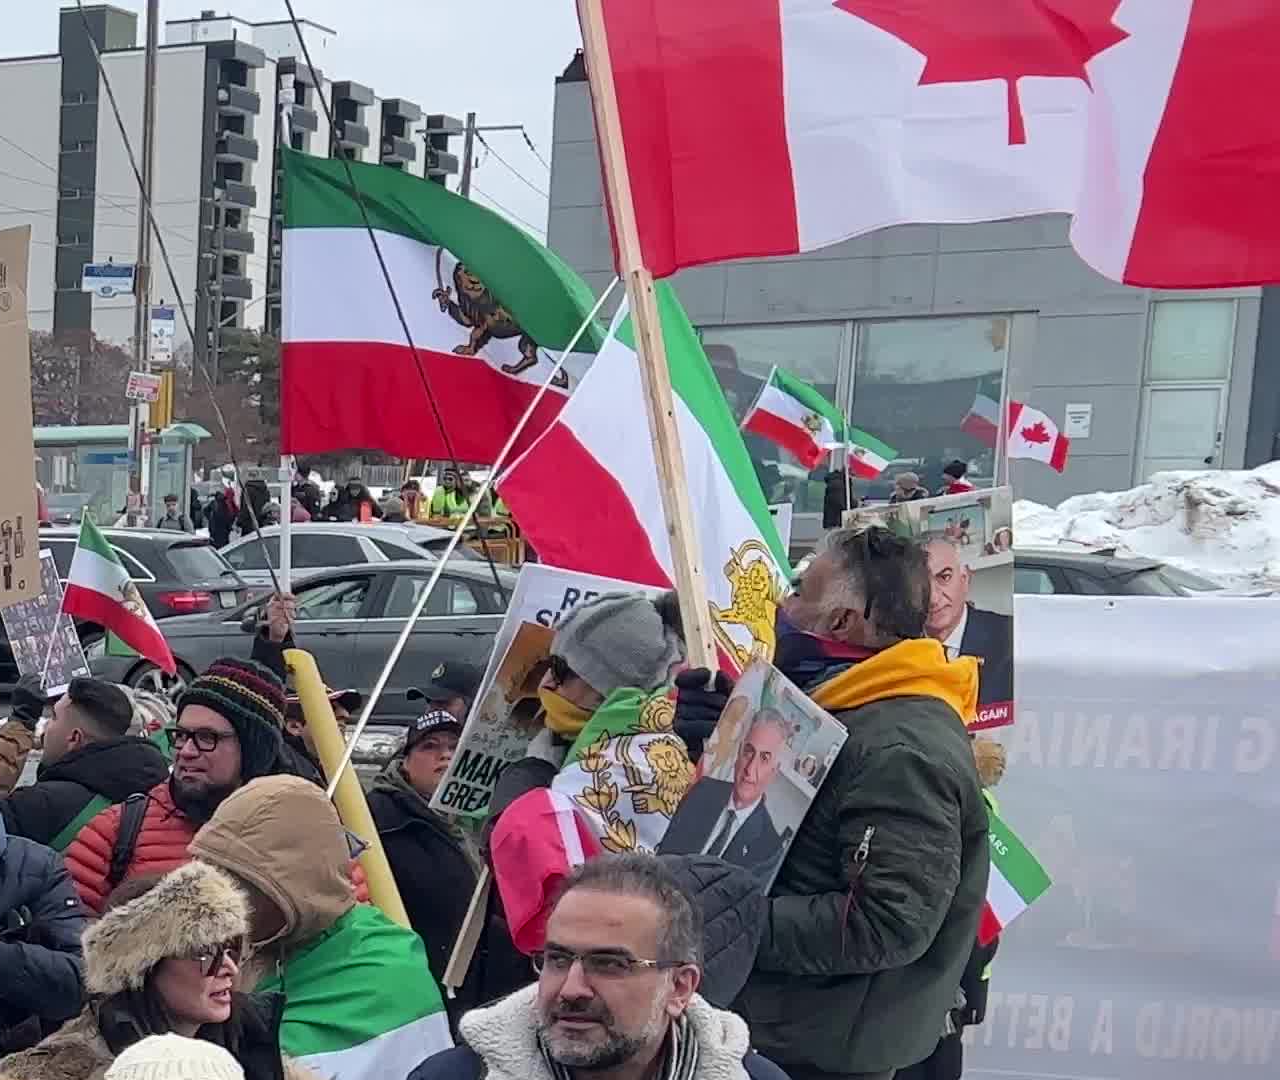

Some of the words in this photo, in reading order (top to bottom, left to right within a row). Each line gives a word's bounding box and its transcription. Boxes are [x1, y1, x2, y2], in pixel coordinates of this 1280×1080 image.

[453, 749, 511, 787] MAK
[440, 781, 492, 812] GREA
[988, 832, 1009, 856] ARS
